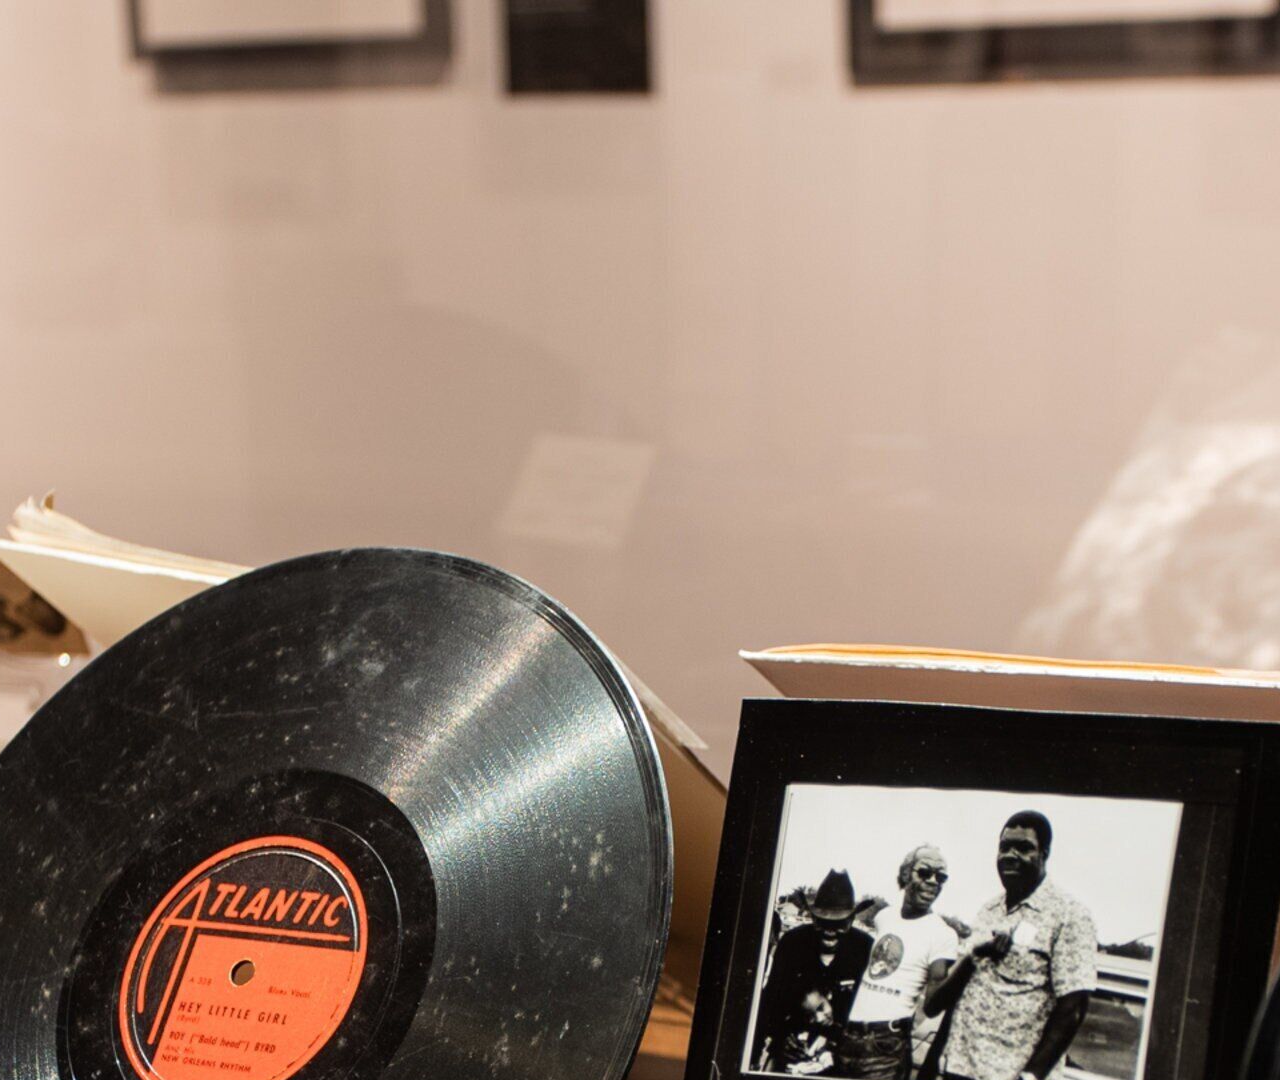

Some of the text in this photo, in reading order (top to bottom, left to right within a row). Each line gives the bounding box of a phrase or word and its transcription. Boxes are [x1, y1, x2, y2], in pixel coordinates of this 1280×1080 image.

[178, 1002, 288, 1025] HEY LITTLE GIRL
[169, 1031, 185, 1040] ROY
[254, 1043, 276, 1053] BYRD
[161, 1054, 251, 1073] NEW ORLEANS RHYTHM
